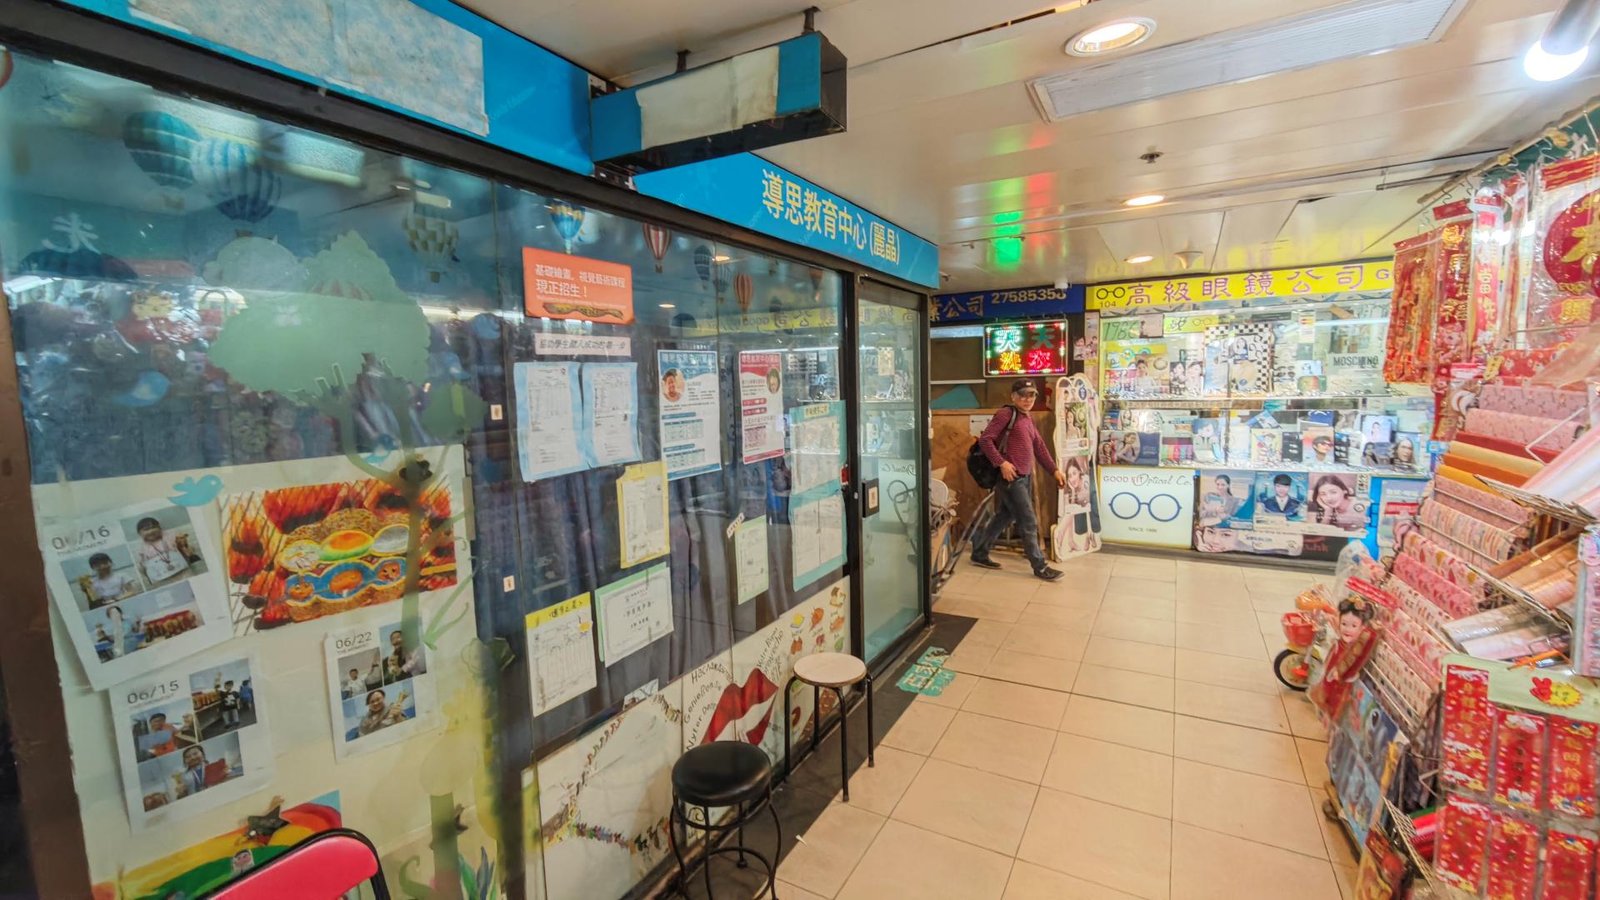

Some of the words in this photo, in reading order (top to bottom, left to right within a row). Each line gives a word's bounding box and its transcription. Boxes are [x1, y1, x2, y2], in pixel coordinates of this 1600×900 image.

[1126, 264, 1364, 306] 高級眼鏡公司
[335, 631, 373, 650] 06/22
[127, 680, 180, 704] 06/15
